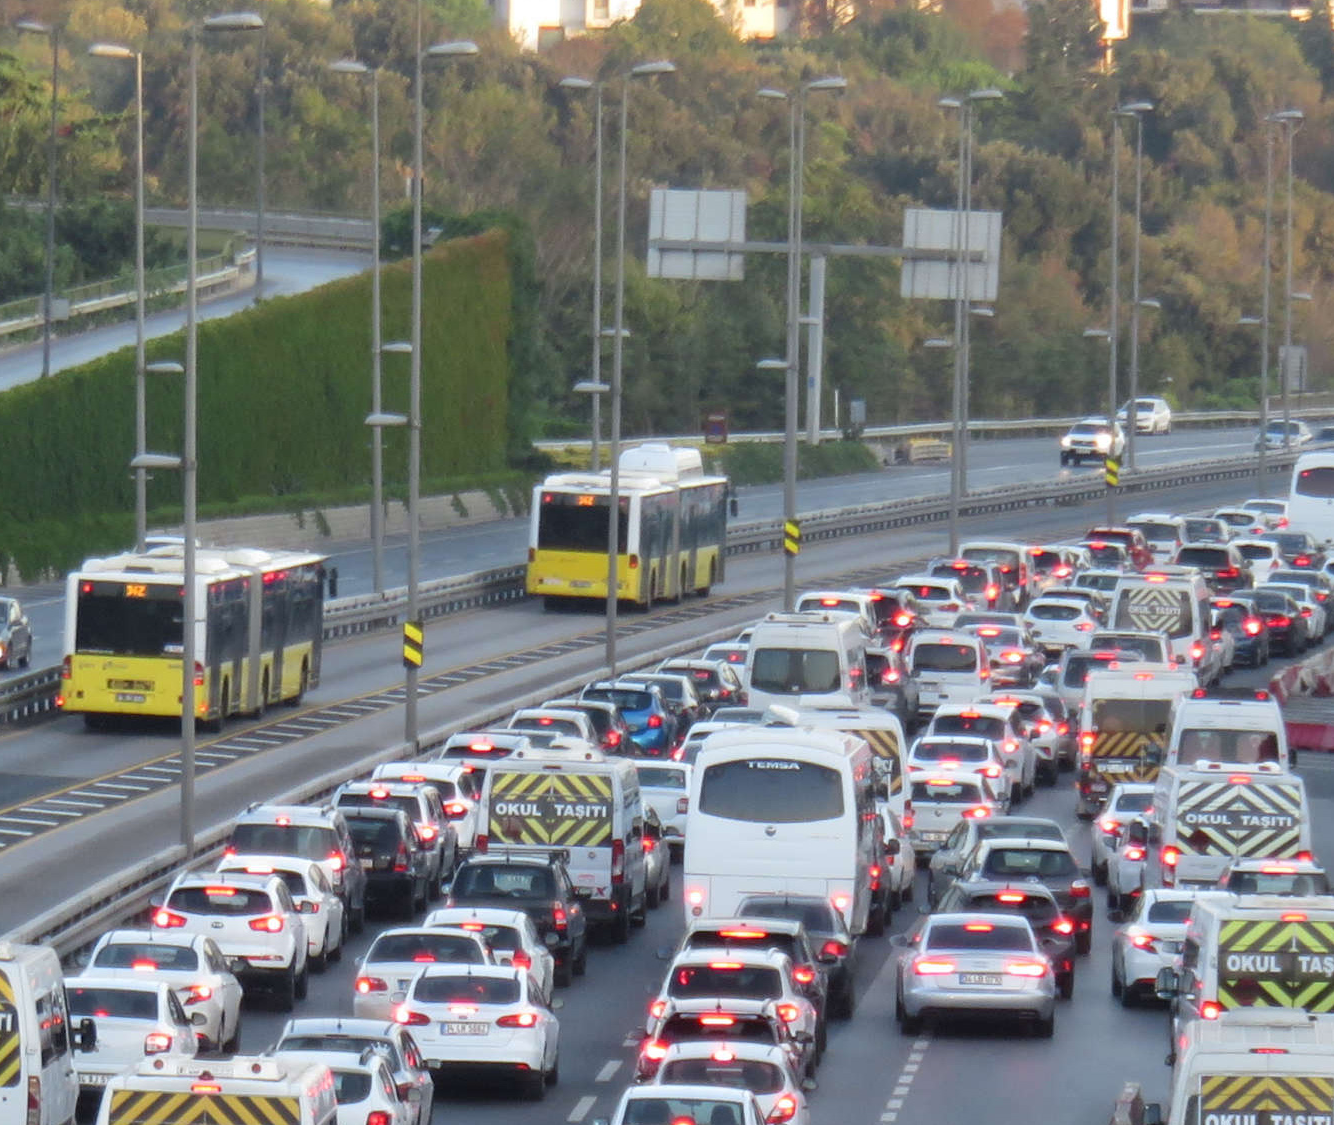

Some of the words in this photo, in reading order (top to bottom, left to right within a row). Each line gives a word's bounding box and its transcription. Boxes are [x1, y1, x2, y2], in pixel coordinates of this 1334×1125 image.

[748, 760, 801, 771] TEMSA
[495, 803, 542, 817] OKUL
[554, 805, 607, 820] TAŞITI
[1186, 813, 1232, 826] OKUL
[1241, 814, 1293, 829] TAŞITI
[1226, 954, 1282, 973] OKUL
